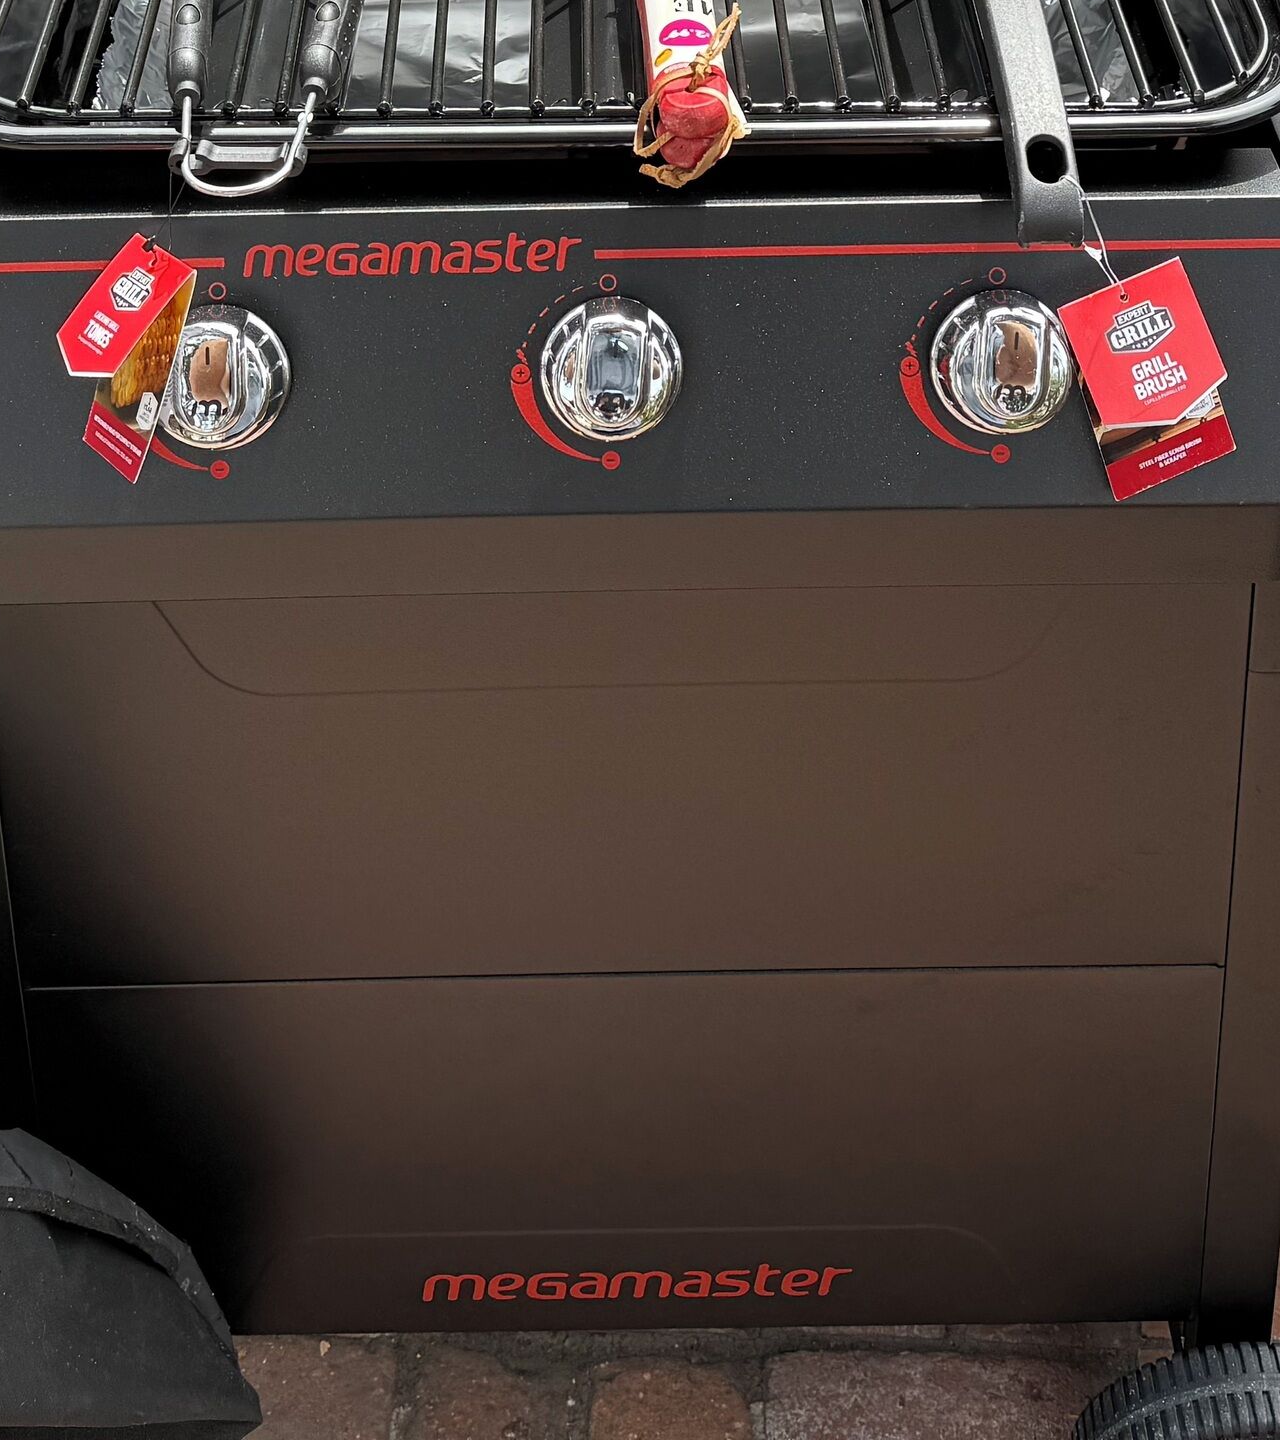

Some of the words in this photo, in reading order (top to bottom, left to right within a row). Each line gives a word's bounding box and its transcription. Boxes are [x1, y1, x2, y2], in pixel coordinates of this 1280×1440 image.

[242, 232, 583, 278] megamaster
[1110, 310, 1172, 350] GRILL
[1116, 303, 1152, 325] EXPERT
[83, 318, 115, 350] TONGS
[1131, 351, 1178, 381] GRILL
[1133, 365, 1188, 401] BRUSH
[422, 1263, 853, 1302] megamaster
